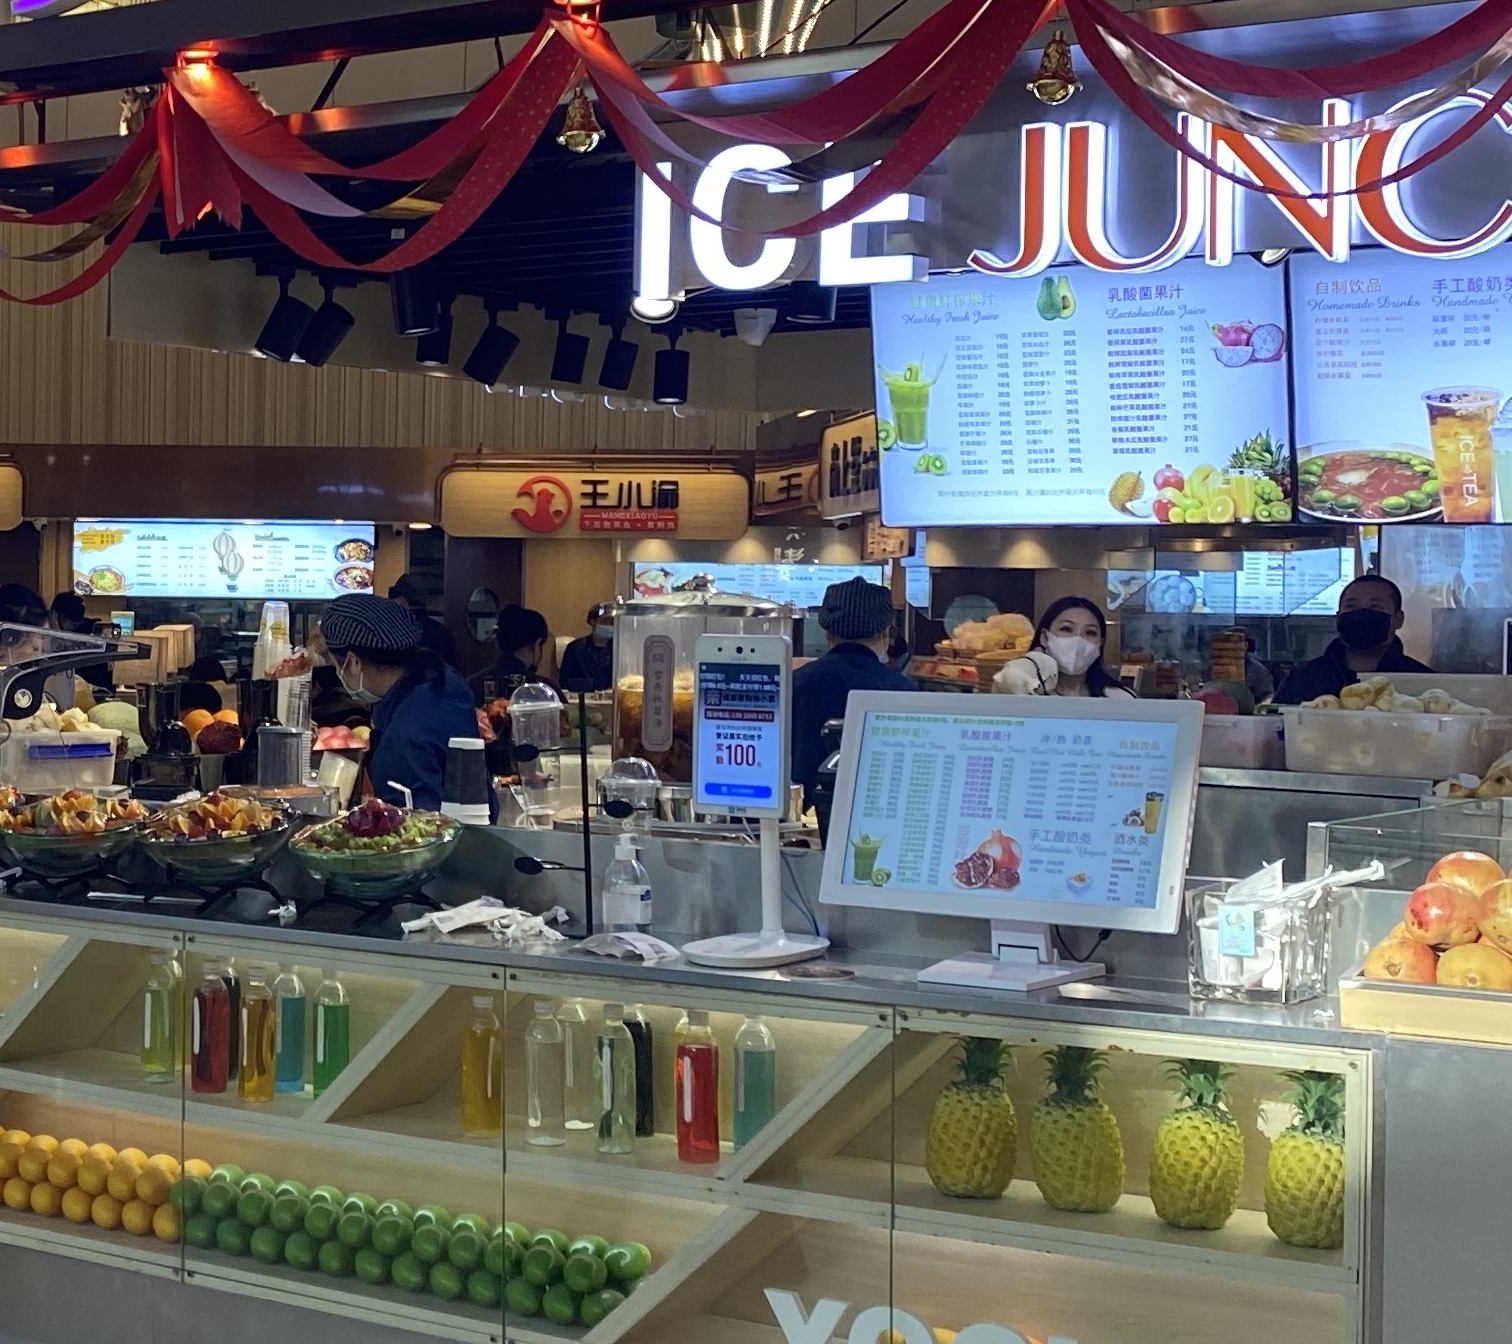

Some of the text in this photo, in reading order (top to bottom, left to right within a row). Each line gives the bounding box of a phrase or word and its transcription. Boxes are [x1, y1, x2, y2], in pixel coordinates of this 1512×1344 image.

[639, 144, 929, 300] ICE
[1108, 284, 1184, 302] 乳酸菌果汁
[1315, 277, 1382, 295] 自制饮品
[1307, 295, 1422, 311] Homemade Drinks
[1432, 295, 1499, 308] Handmade
[944, 310, 970, 323] Fresh
[972, 311, 1000, 325] Juice
[1105, 304, 1208, 319] Lactobacillus Juice
[1459, 435, 1479, 507] ICE TEA
[961, 729, 1012, 742] 乳酸菌果汁
[1072, 735, 1093, 746] 奶茶
[726, 744, 756, 766] 100
[1028, 829, 1092, 845] 手工酸奶类
[1114, 833, 1150, 847] 酒水类
